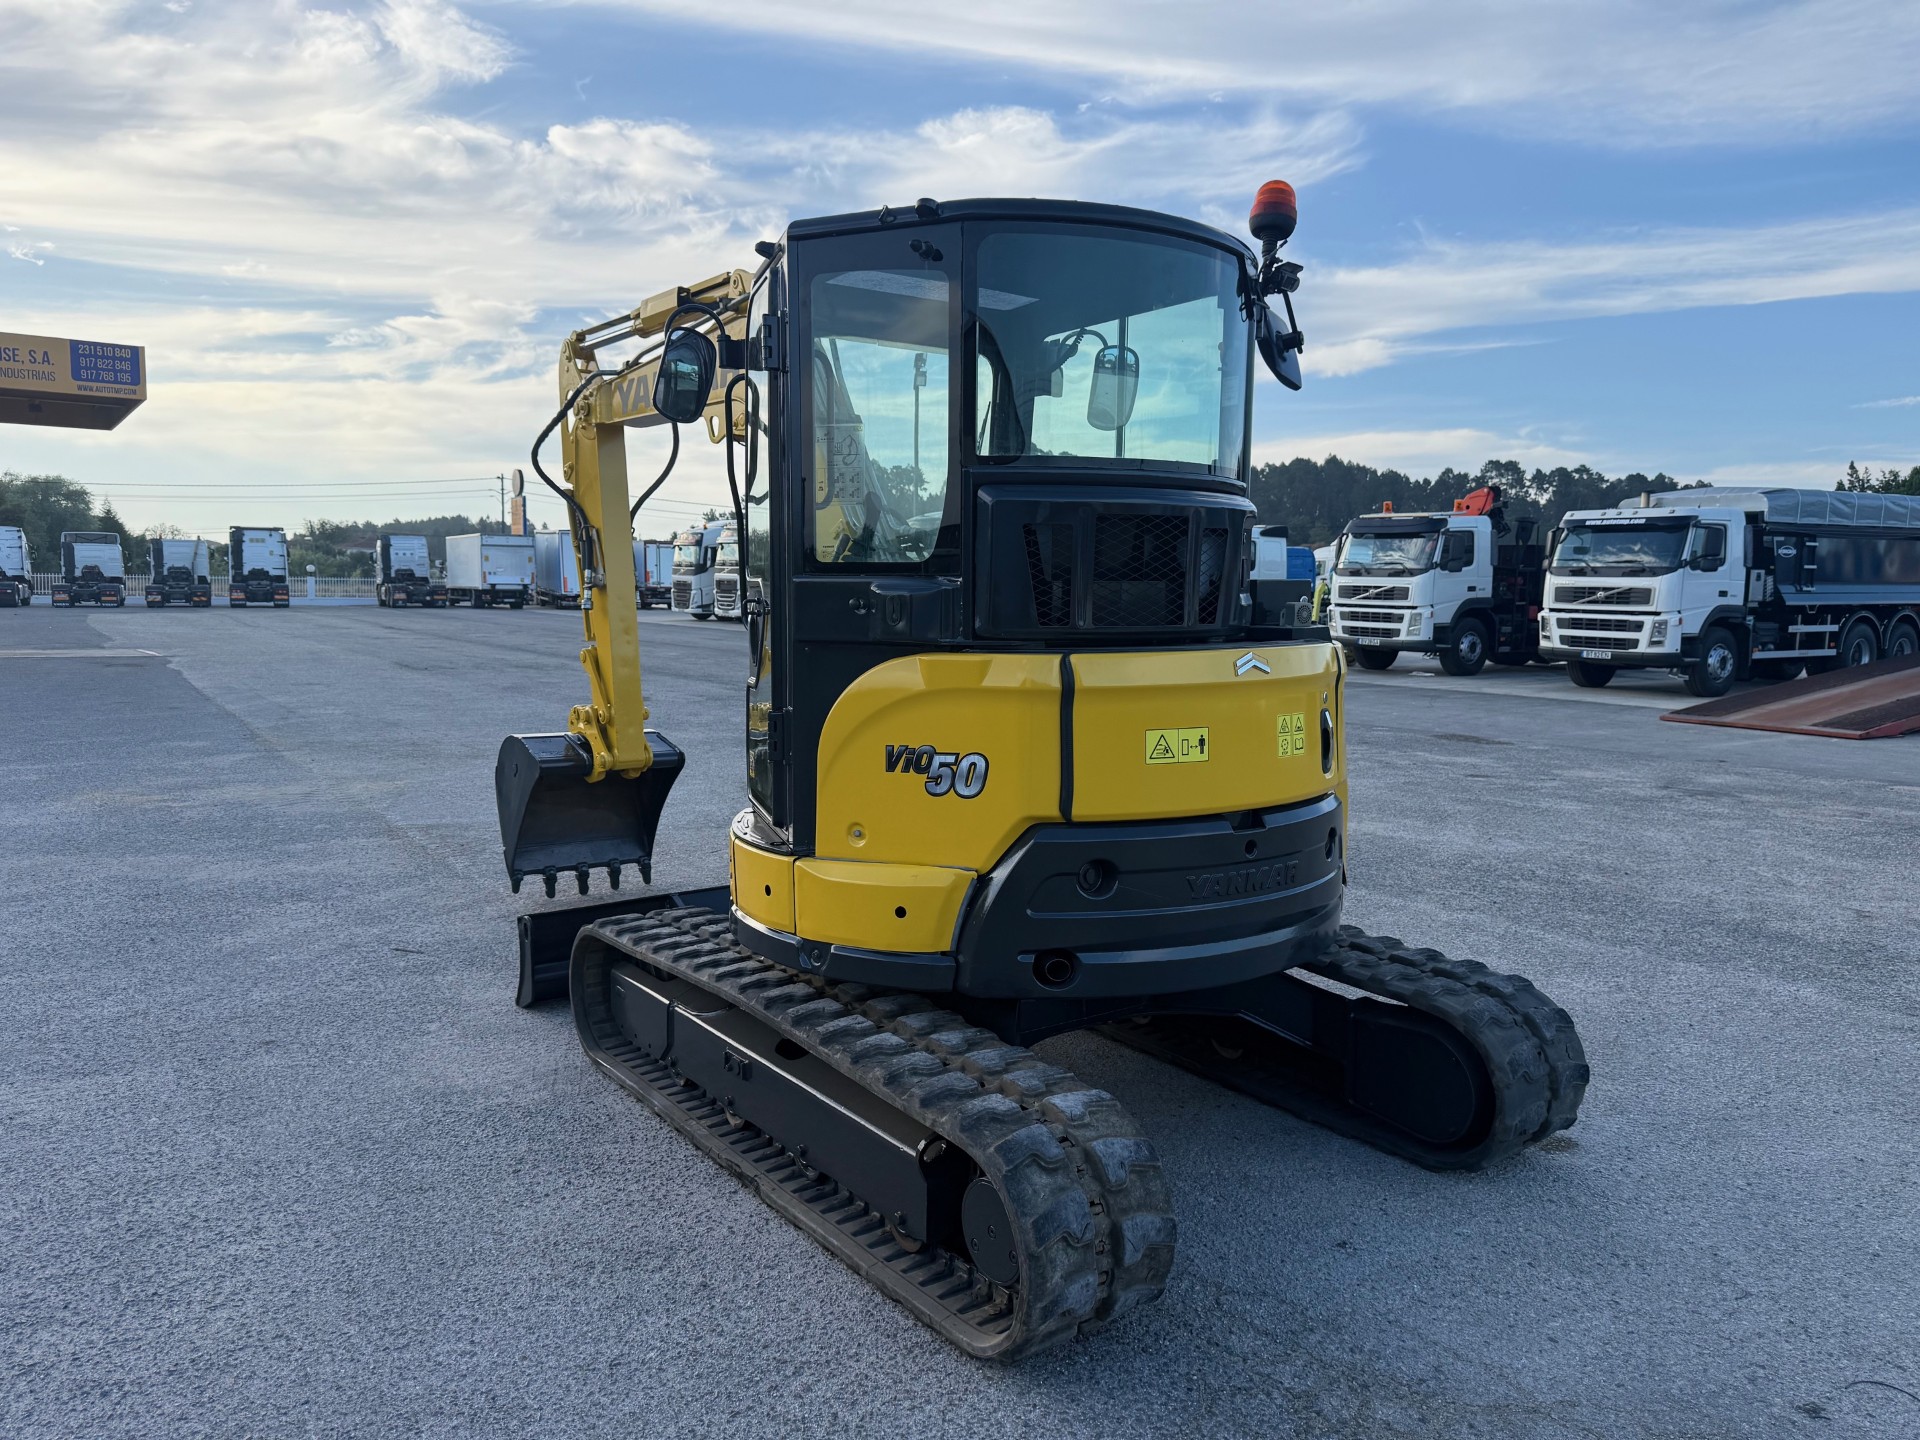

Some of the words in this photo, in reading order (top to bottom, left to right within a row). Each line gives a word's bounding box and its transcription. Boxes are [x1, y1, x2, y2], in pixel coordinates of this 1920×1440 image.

[0, 346, 24, 364] SE,
[28, 349, 55, 366] S.A.
[78, 344, 94, 355] 231
[97, 346, 113, 357] 510
[115, 347, 131, 358] 840
[80, 356, 95, 367] 917
[97, 358, 113, 369] 822
[115, 360, 131, 371] 846
[81, 369, 96, 379] 917
[99, 371, 114, 381] 768
[117, 373, 131, 383] 195
[1186, 860, 1299, 899] YANMAR
